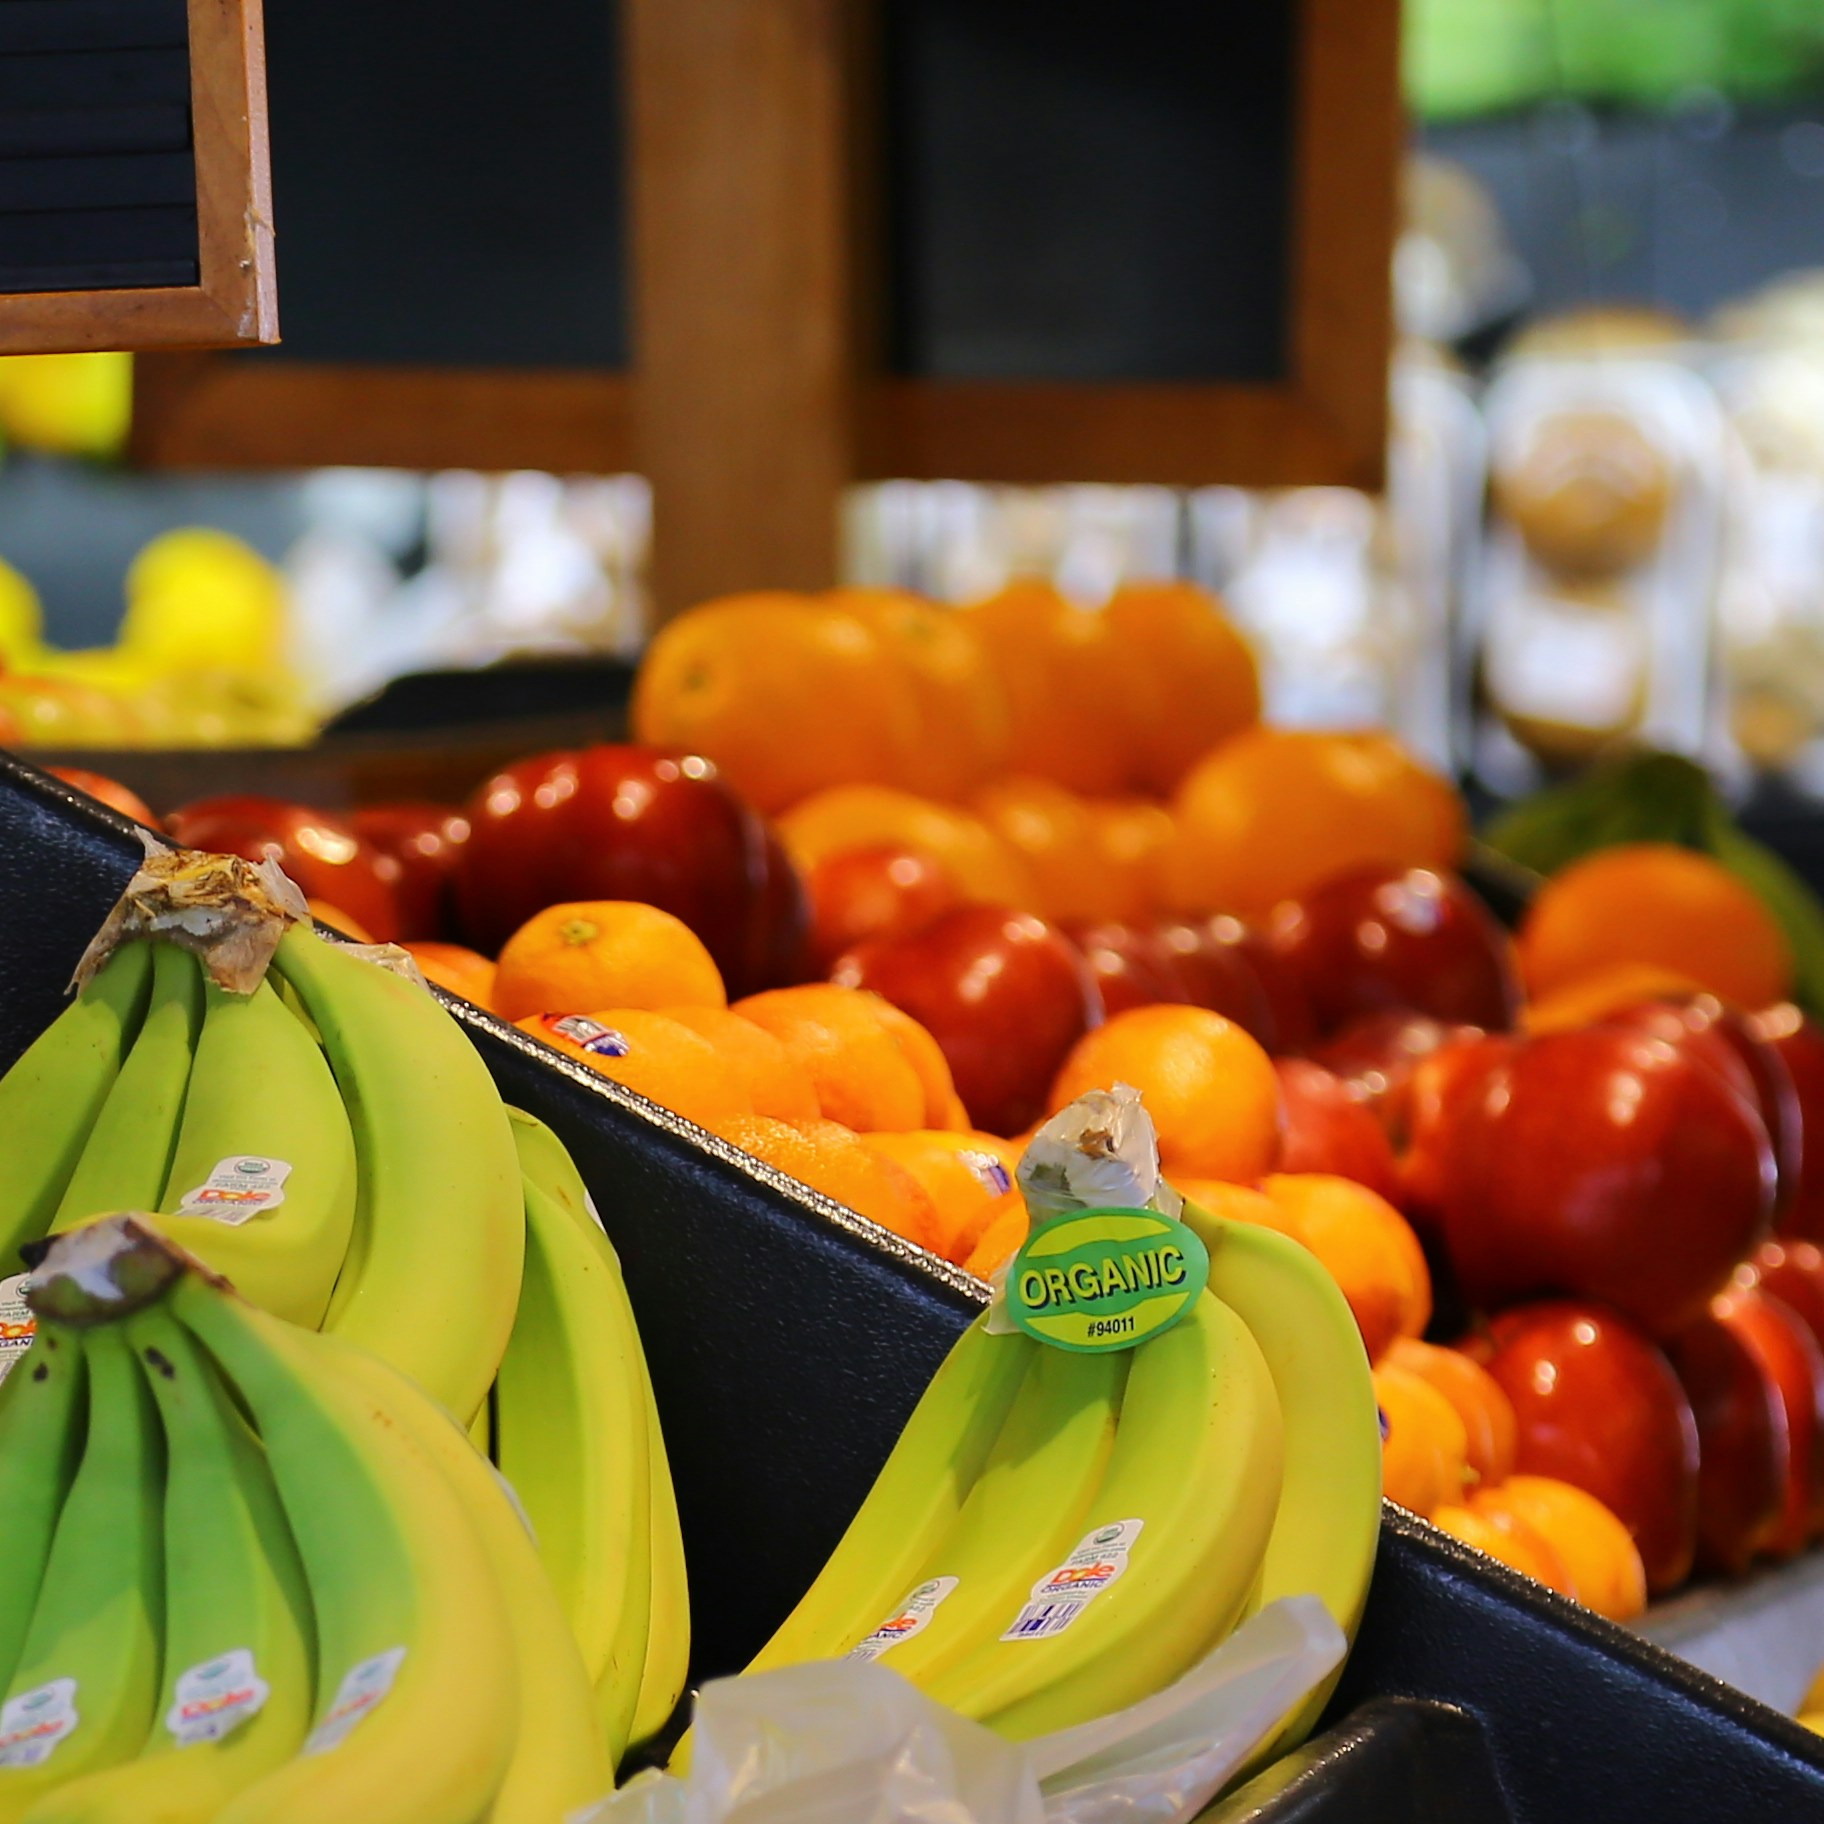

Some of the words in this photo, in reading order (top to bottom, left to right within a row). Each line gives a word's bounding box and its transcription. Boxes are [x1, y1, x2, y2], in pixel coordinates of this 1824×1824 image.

[1019, 1245, 1187, 1310] ORGANIC
[1087, 1316, 1136, 1337] #94011
[1051, 1560, 1116, 1585] Dole
